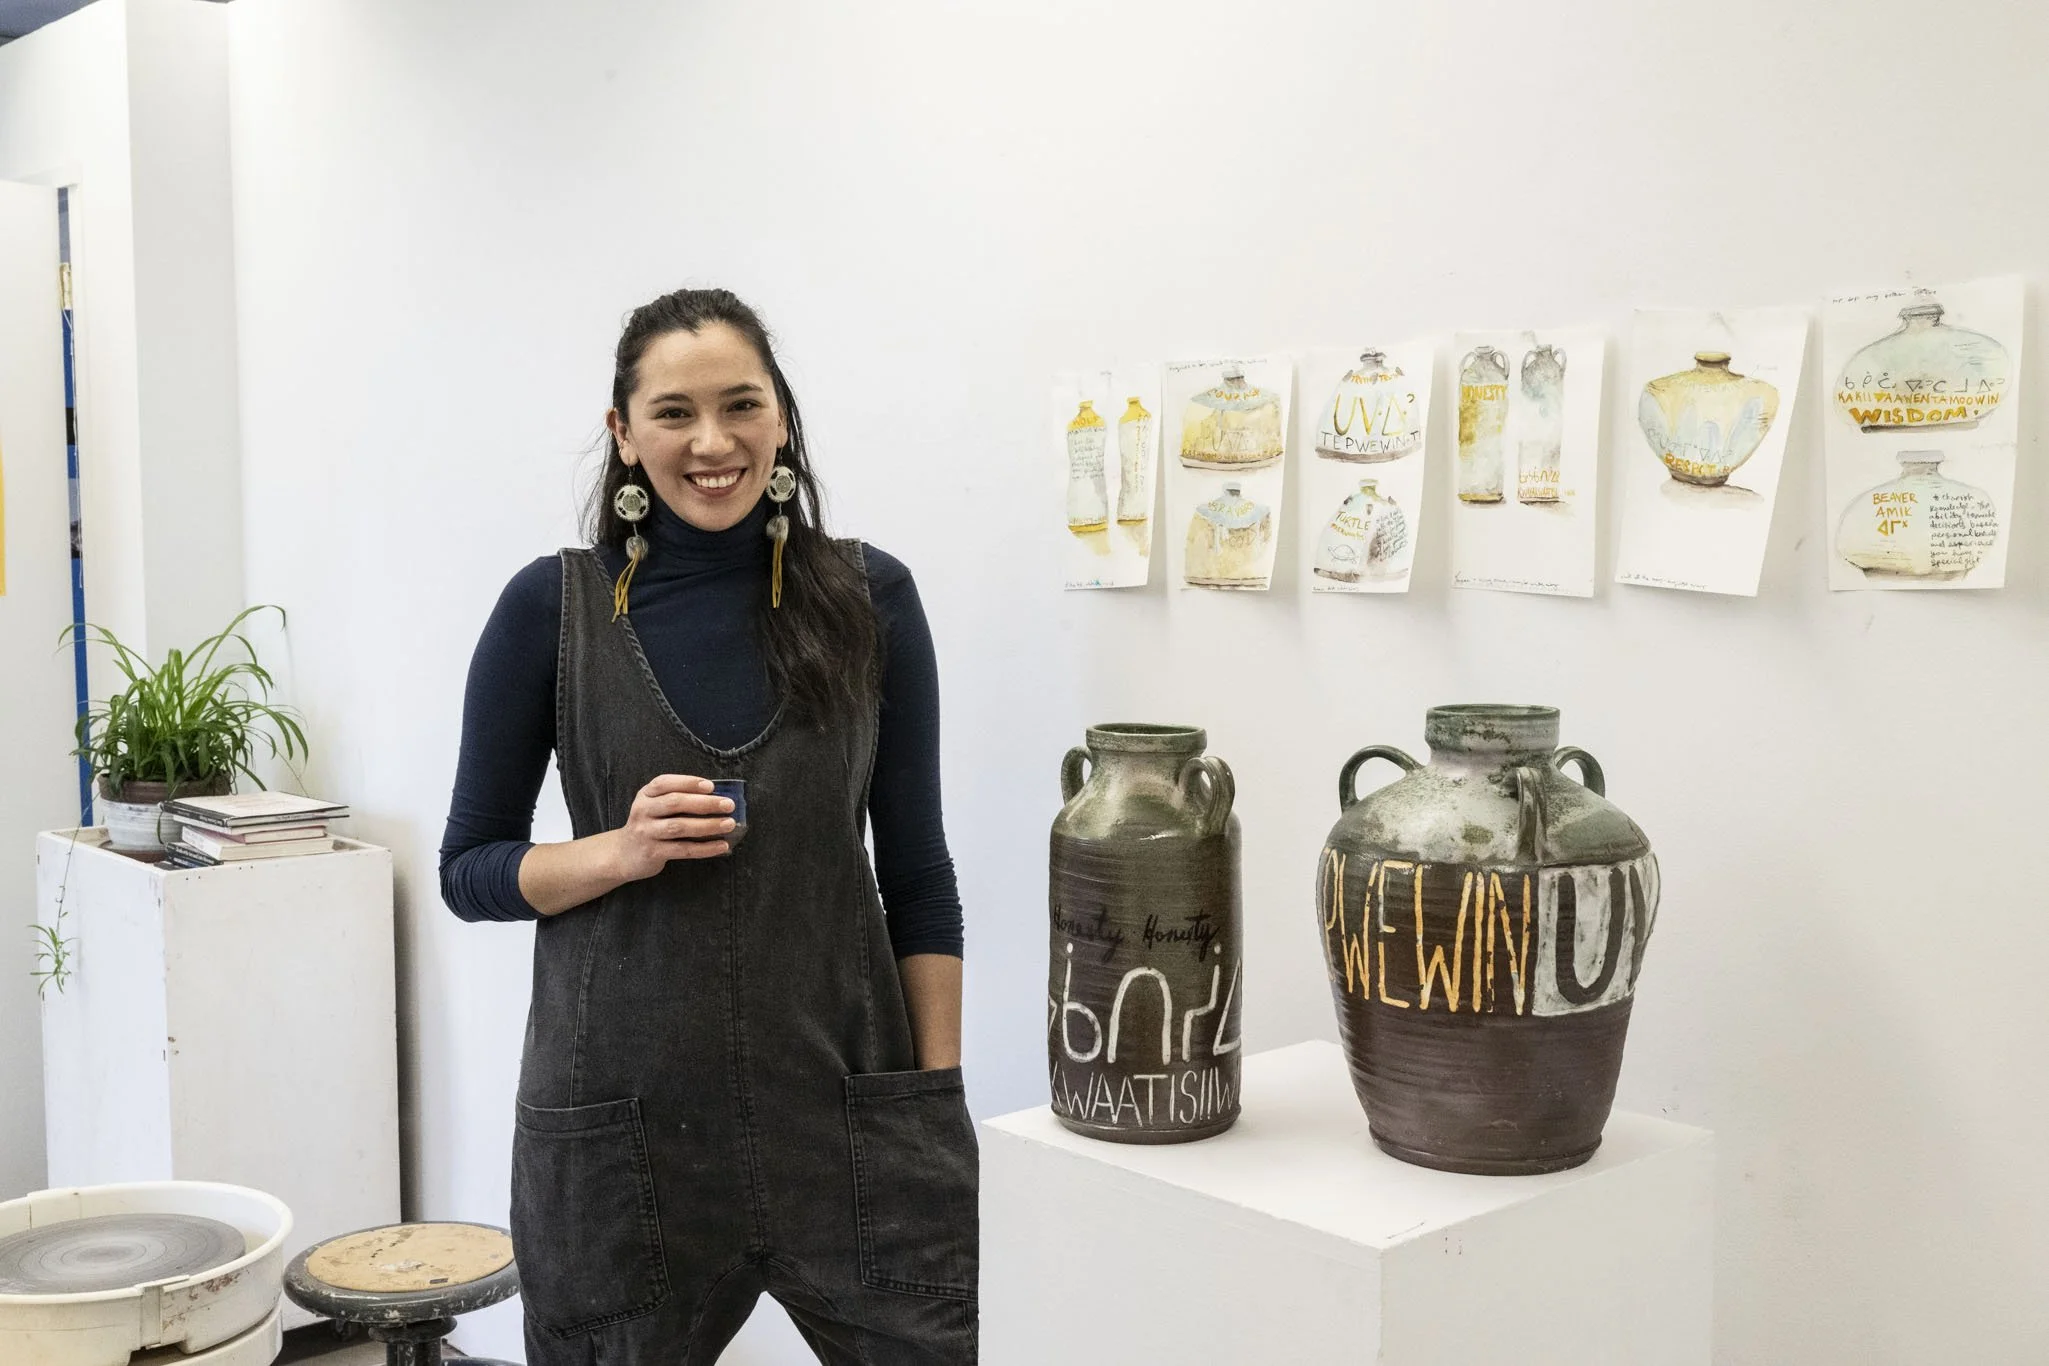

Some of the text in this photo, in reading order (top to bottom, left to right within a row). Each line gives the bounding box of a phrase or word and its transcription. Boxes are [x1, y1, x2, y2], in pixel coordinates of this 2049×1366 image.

[1873, 493, 1918, 504] BEAVER
[1876, 507, 1912, 517] AMIK
[1142, 910, 1221, 963] Honesty
